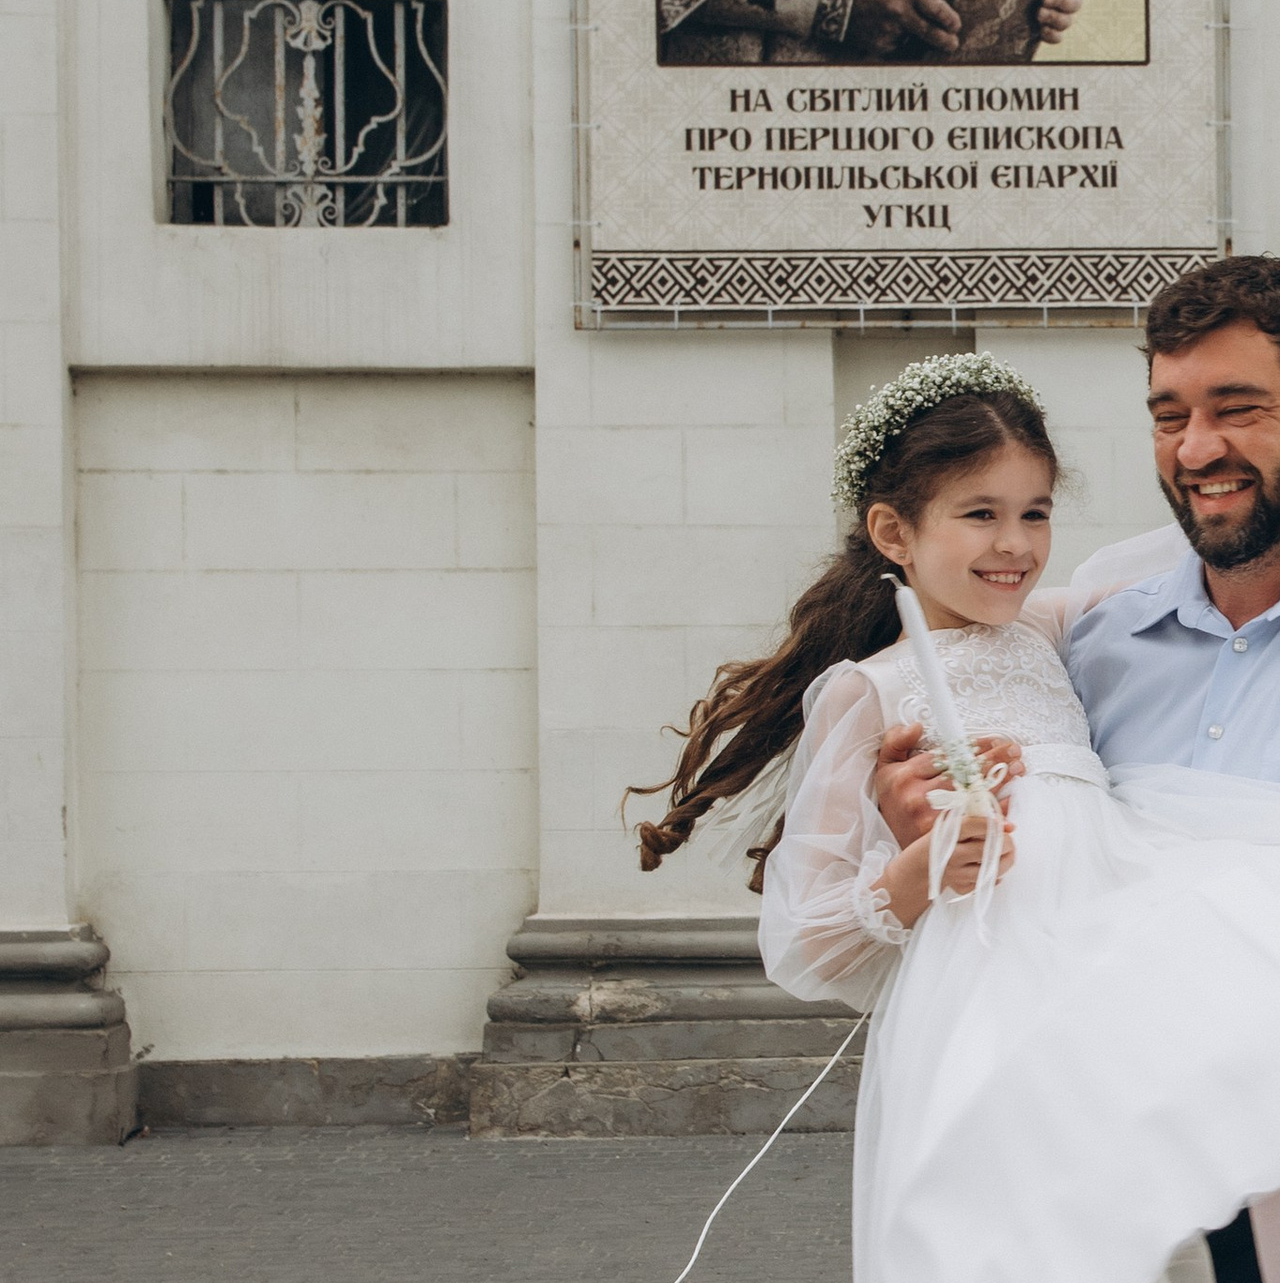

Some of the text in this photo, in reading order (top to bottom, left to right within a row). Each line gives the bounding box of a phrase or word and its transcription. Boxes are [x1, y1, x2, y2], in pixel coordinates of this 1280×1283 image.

[729, 81, 1080, 113] НА СВІТЛИЙ СПОМИН
[684, 125, 1125, 152] ПРО ПЕРШОГО ЄПИСКОПА
[691, 159, 1118, 191] ТЕРНОПІЛЬСЬКОЇ ЄПАРХІЇ
[862, 203, 952, 233] УГКЦ
